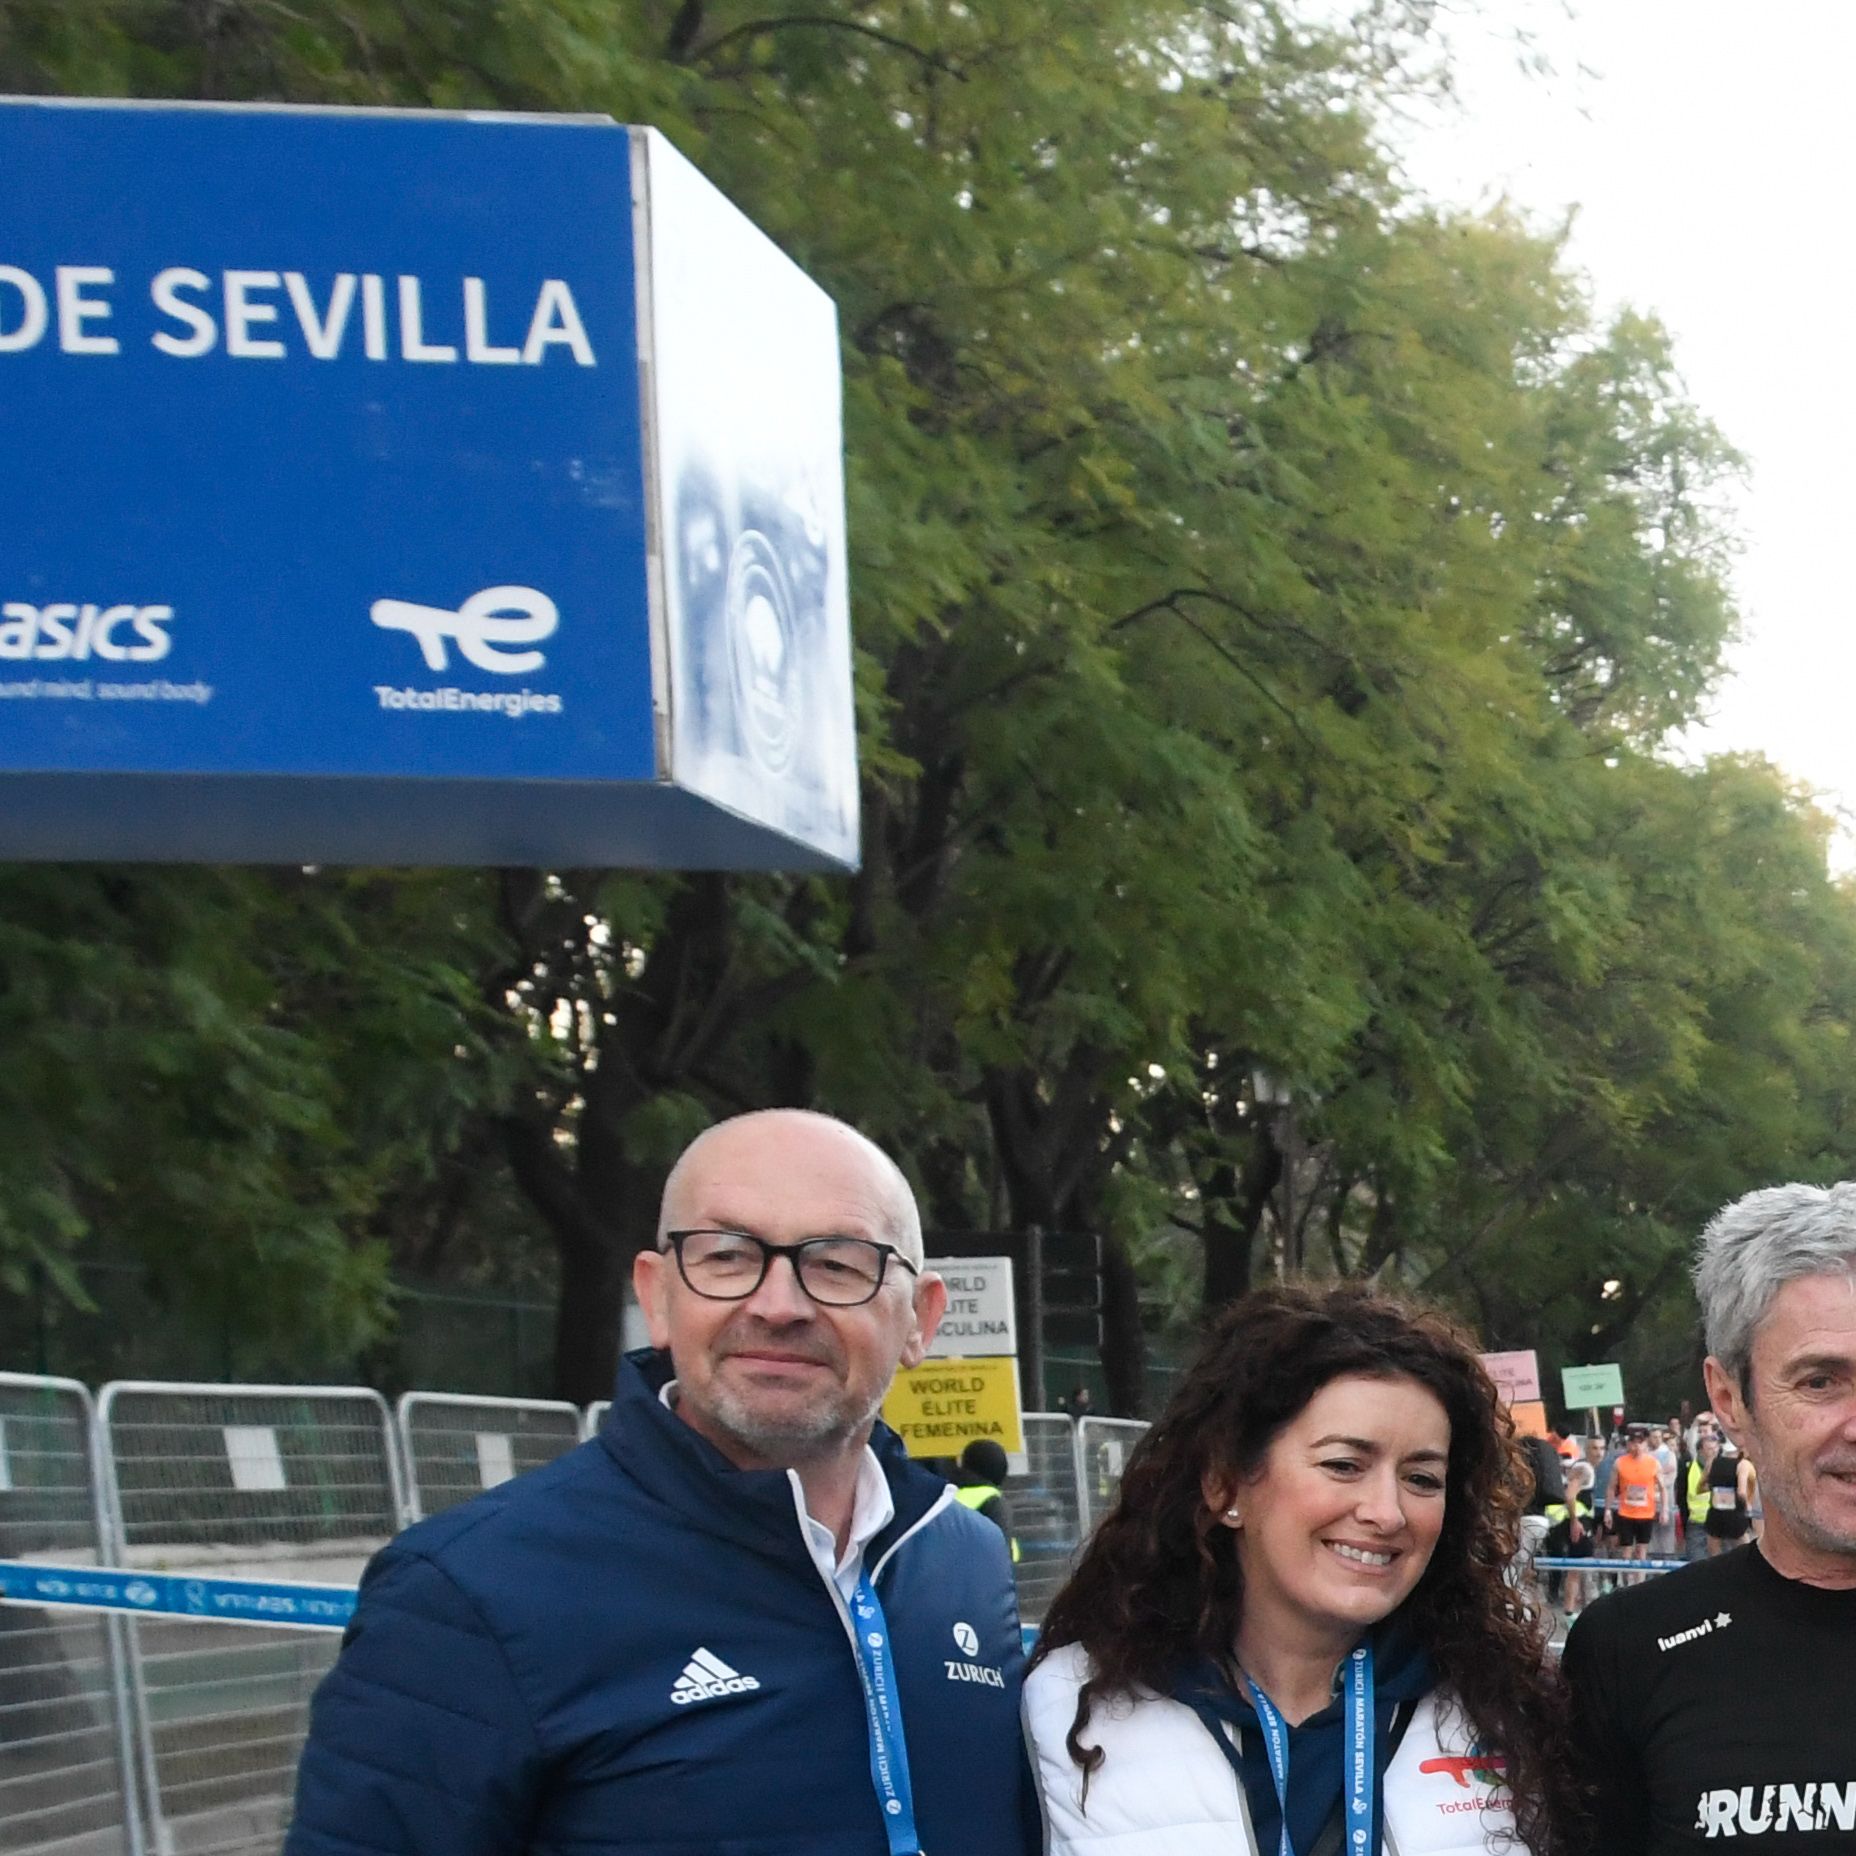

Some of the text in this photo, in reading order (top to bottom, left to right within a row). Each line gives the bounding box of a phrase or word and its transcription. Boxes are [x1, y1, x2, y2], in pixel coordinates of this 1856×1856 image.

[151, 265, 597, 367] SEVILLA
[372, 685, 563, 718] TotalEnergies
[909, 1377, 985, 1395] WORLD
[943, 1661, 1005, 1690] ZURICH
[670, 1676, 761, 1705] adidas
